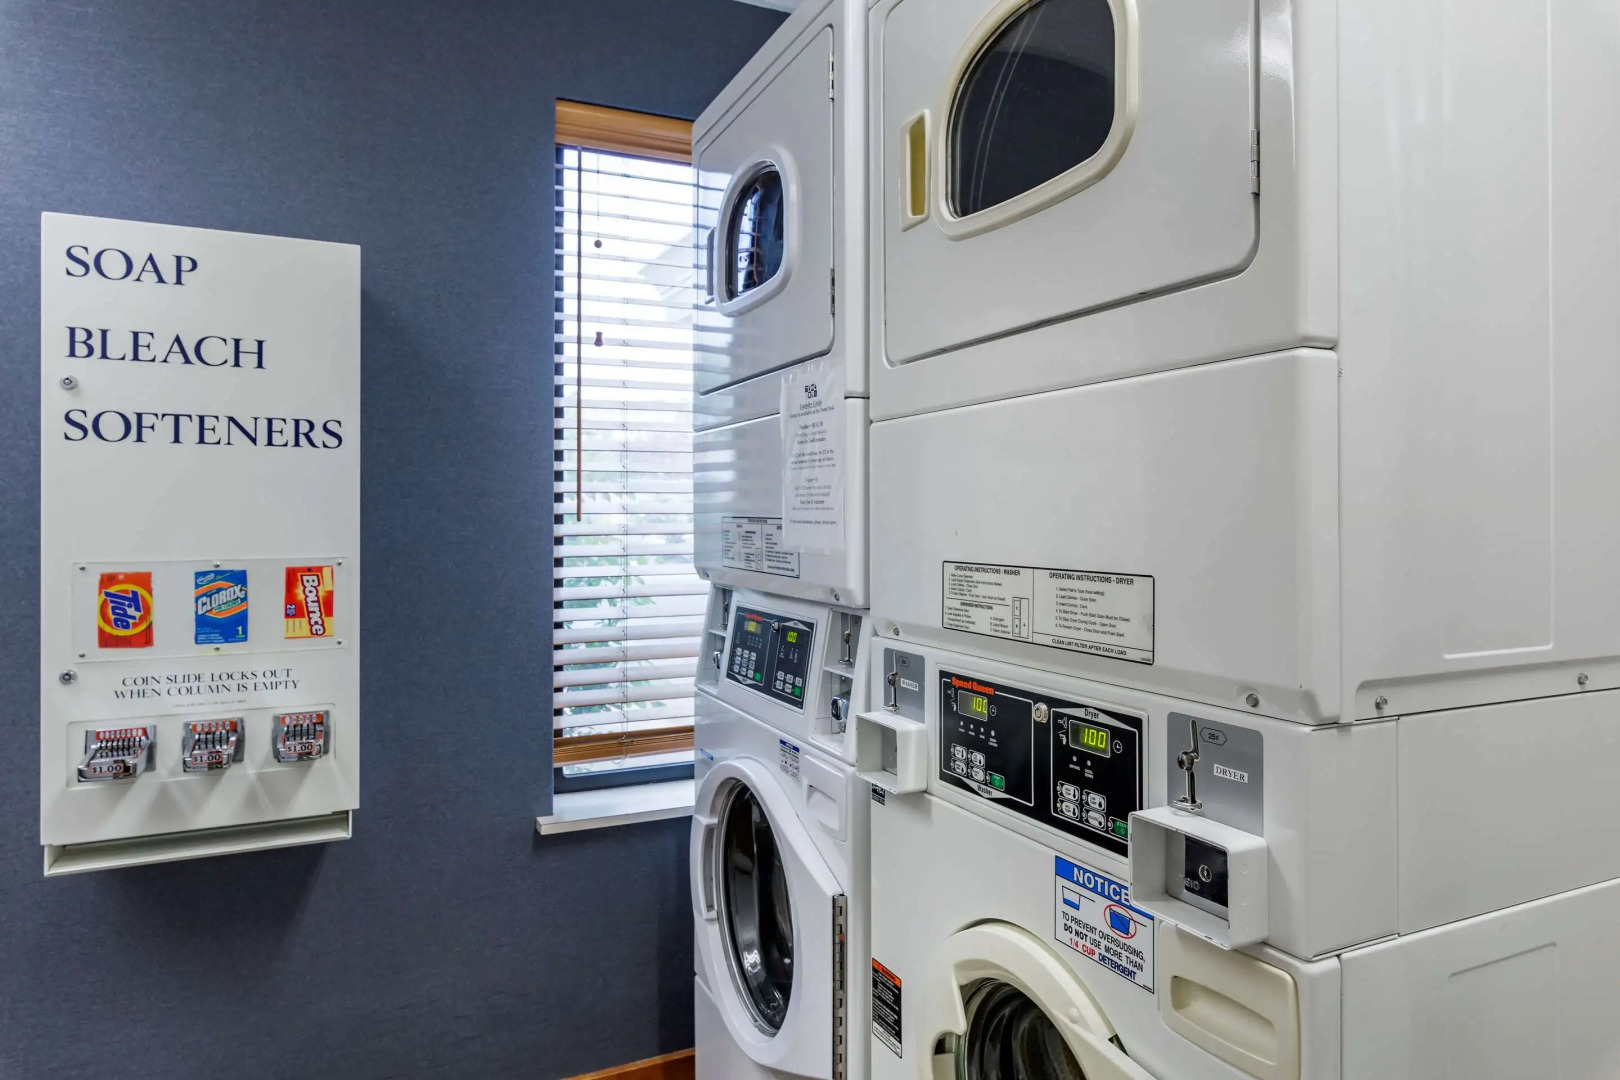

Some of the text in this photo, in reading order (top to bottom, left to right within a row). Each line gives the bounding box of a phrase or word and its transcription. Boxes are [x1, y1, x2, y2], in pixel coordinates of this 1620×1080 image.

[65, 245, 198, 286] SOAP
[65, 326, 267, 369] BLEACH
[63, 408, 343, 449] SOFTENERS
[975, 566, 1001, 574] INSTRUCTIONS
[1049, 572, 1075, 581] OPERATING
[1076, 574, 1112, 583] INSTRUCTIONS
[1116, 577, 1134, 585] DRYER
[103, 589, 143, 630] Tide
[302, 575, 324, 635] Bounce
[1088, 644, 1101, 652] AFTER
[1102, 646, 1114, 654] EACH
[1115, 648, 1126, 656] LOAD
[122, 668, 293, 687] COIN SLIDE LOCKS OUT
[951, 676, 995, 695] Speed Queen
[114, 679, 300, 700] WHEN COLUMN IS EMPTY
[1084, 708, 1100, 720] Dryer
[1085, 728, 1107, 748] 100
[287, 743, 313, 753] $1.00
[193, 753, 221, 764] $1.00
[92, 764, 122, 774] $1.00
[1215, 766, 1246, 782] DRYER
[977, 783, 993, 797] Washer
[1073, 867, 1131, 906] NOTICE
[1062, 911, 1145, 963] TO PREVENT OVERSUDSING,
[1064, 923, 1143, 972] DO NOT USE MORE THAN
[1069, 938, 1137, 980] 1/4 CUP DETERGENT
